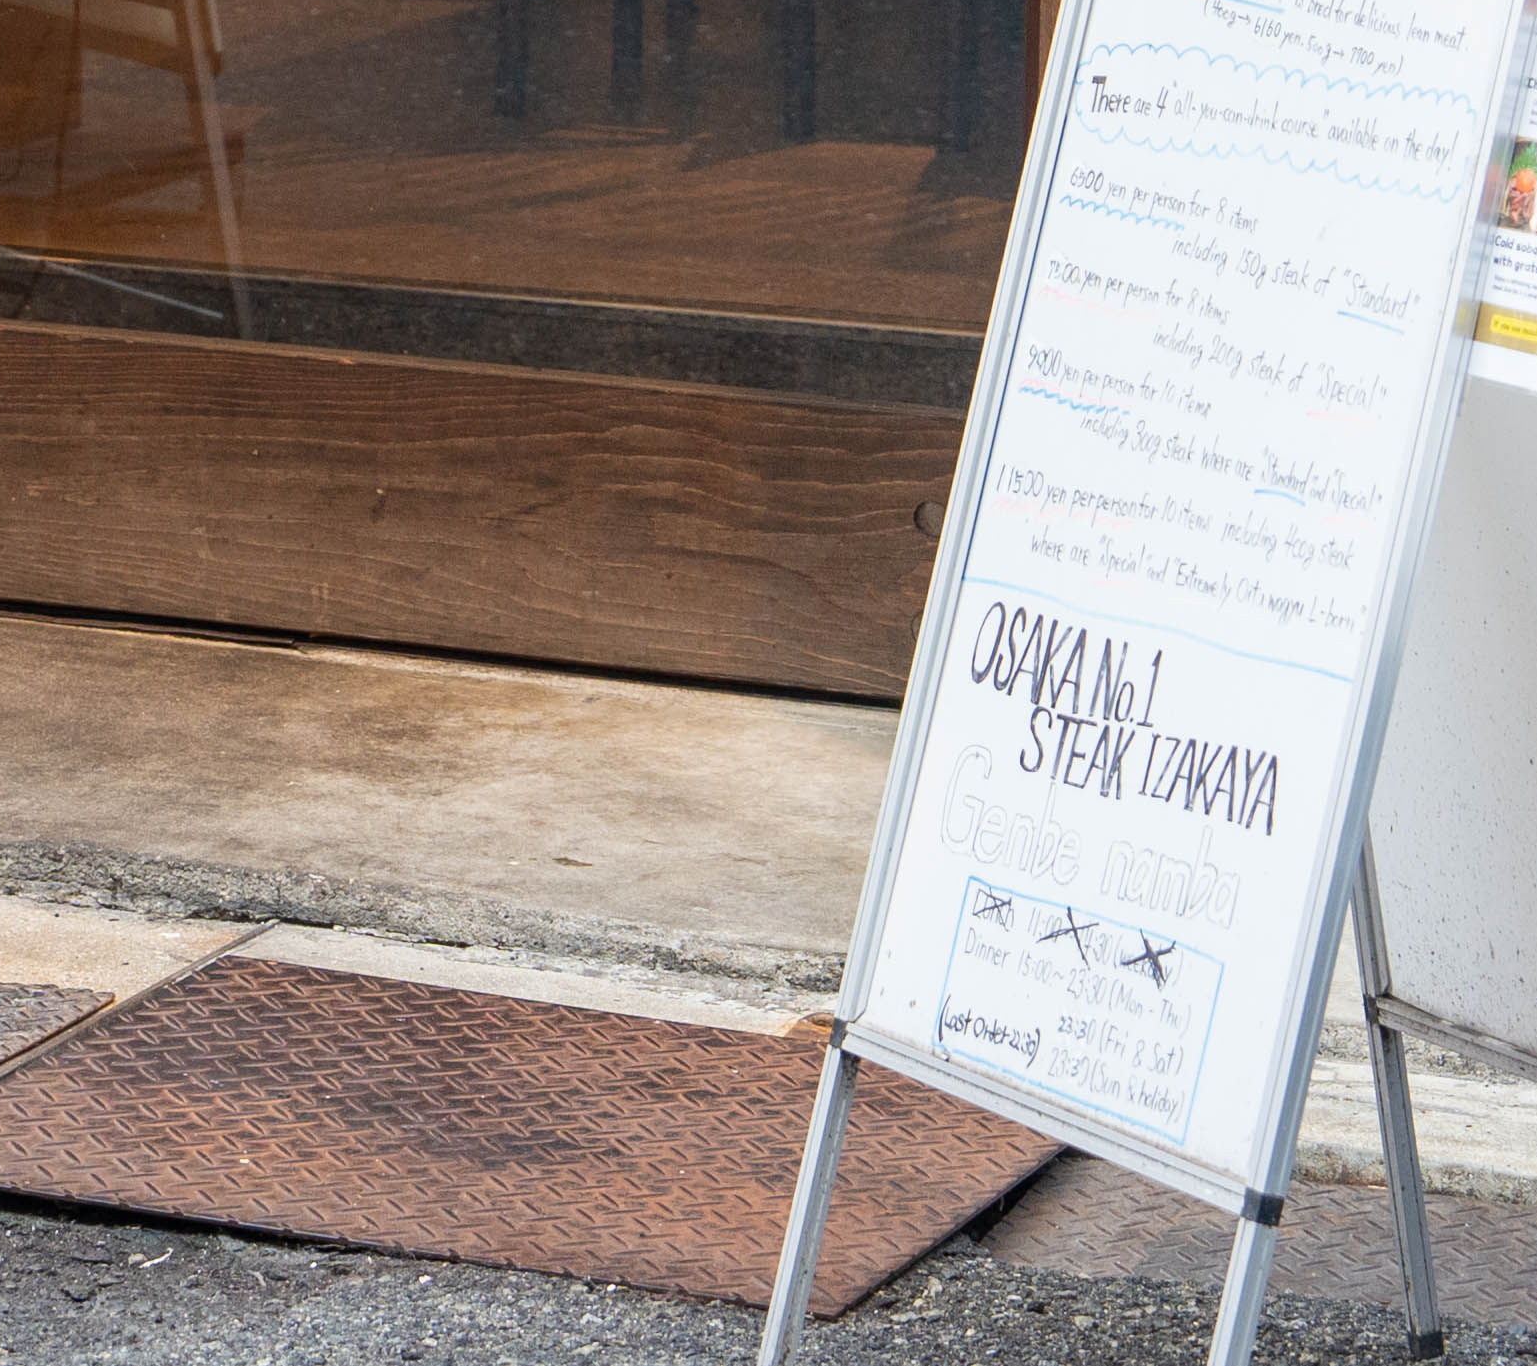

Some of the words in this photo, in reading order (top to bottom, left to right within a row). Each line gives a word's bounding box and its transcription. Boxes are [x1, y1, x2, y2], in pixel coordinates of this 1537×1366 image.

[1091, 75, 1132, 114] There
[1133, 96, 1152, 117] are
[1155, 86, 1169, 118] 4
[1328, 117, 1378, 151] available
[1103, 180, 1127, 206] yen
[1128, 184, 1150, 213] per
[1148, 191, 1187, 220] person
[1215, 196, 1228, 224] 8
[1228, 206, 1259, 234] items
[1124, 281, 1161, 308] person
[1272, 258, 1311, 291] steak
[1099, 373, 1136, 405] person
[1040, 484, 1068, 514] yen
[1069, 489, 1092, 518] per
[1091, 494, 1136, 529] person
[1031, 524, 1065, 562] where
[971, 601, 1088, 715] OSAKA
[1019, 705, 1136, 801] STEAK
[1138, 733, 1279, 837] IZAKAYA
[941, 744, 1082, 886] Genbe
[1100, 825, 1241, 930] namba
[964, 927, 1012, 967] Dinner
[973, 1016, 1011, 1046] Order
[1132, 1037, 1148, 1069] &
